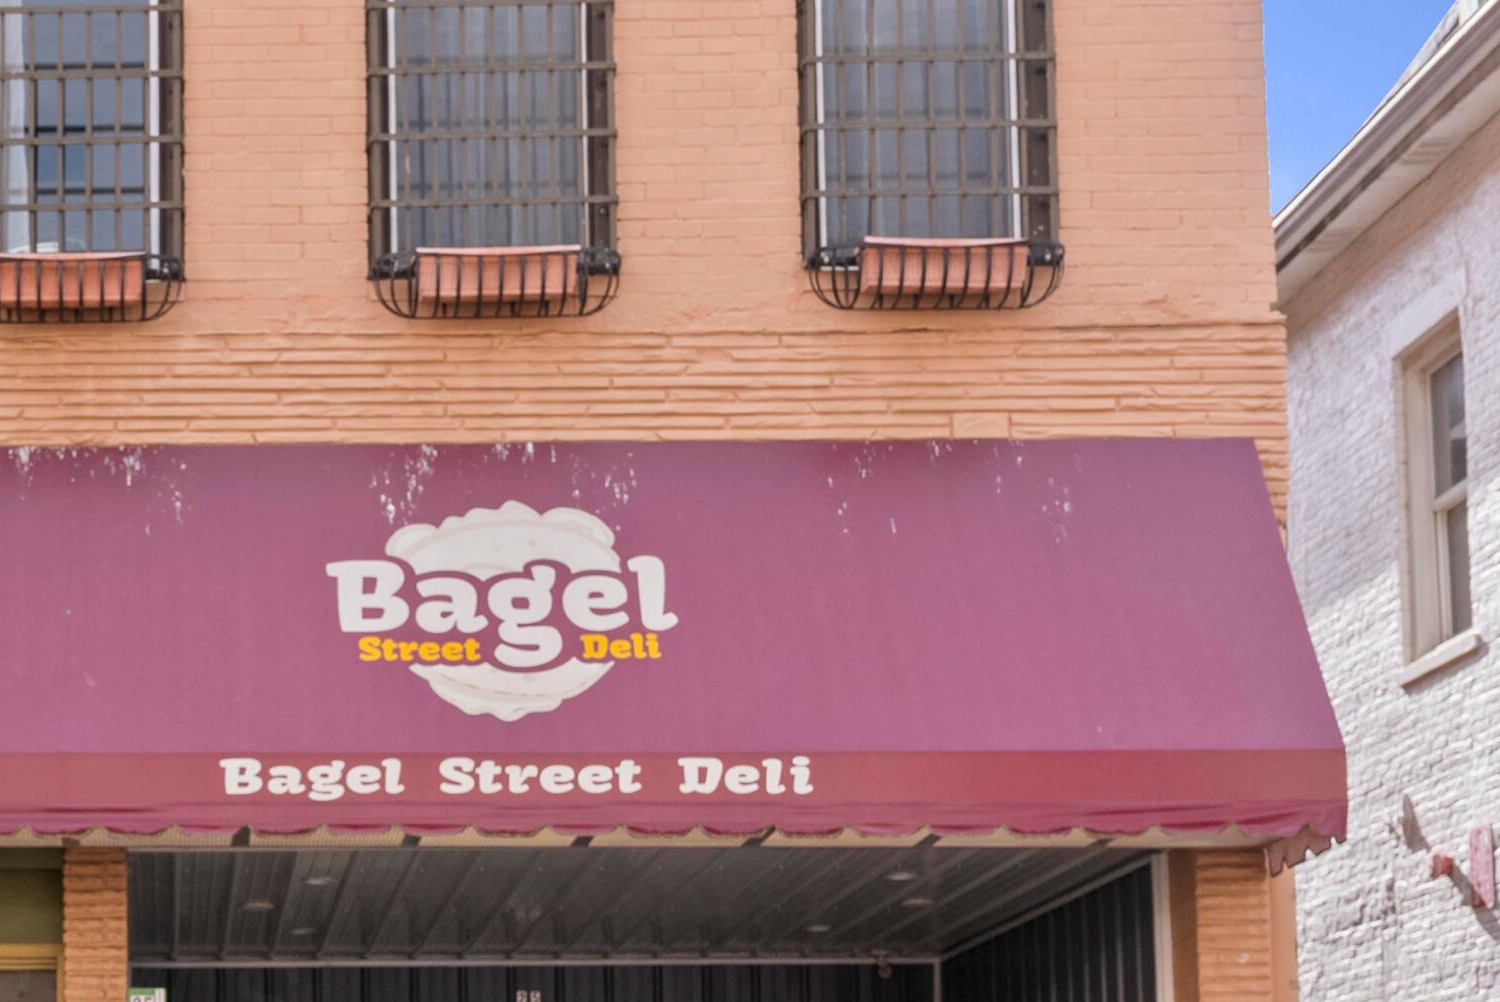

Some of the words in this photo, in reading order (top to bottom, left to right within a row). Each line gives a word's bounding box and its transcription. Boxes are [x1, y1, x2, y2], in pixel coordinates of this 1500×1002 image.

[326, 555, 679, 668] Bagel
[358, 636, 481, 661] Street
[580, 633, 662, 660] Deli
[219, 758, 405, 801] Bagel
[438, 757, 642, 794] Street
[678, 756, 814, 794] Deli
